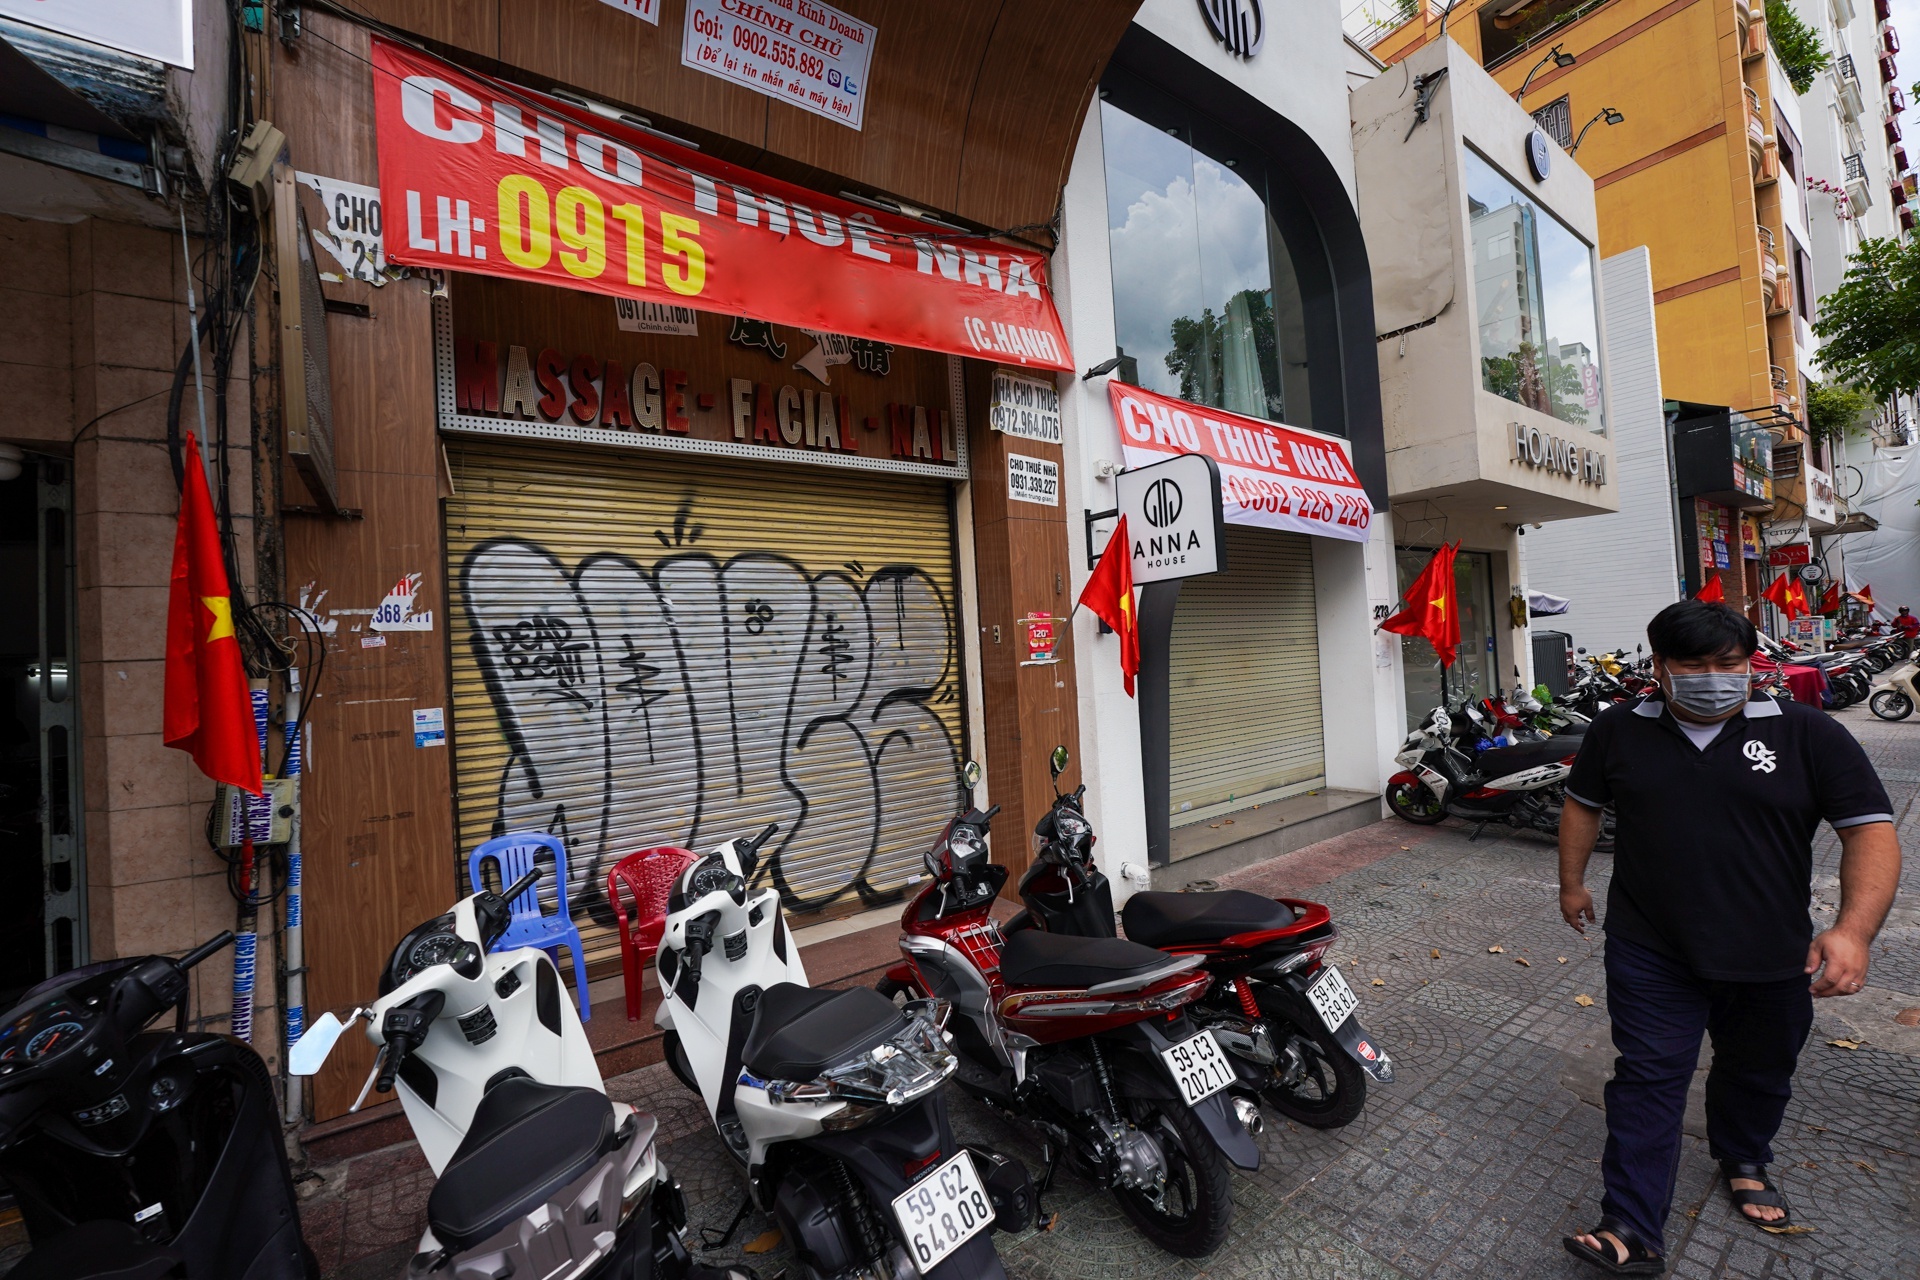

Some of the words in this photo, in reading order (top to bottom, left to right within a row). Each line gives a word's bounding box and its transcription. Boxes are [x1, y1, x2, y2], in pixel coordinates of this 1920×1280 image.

[721, 0, 795, 35] CHÍNH
[799, 29, 844, 56] CHỦ
[796, 0, 826, 26] Kinh
[828, 15, 865, 44] Doanh
[693, 9, 723, 42] Gọi:
[733, 25, 824, 80] 0902.555.882
[723, 53, 738, 72] lại
[743, 63, 758, 78] tin
[761, 71, 784, 88] nhắn
[809, 92, 828, 109] máy
[400, 75, 643, 186] CHO
[677, 168, 892, 264] THUÊ
[912, 236, 1043, 301] NHÀ
[335, 192, 382, 237] CHO
[406, 189, 487, 261] LH:
[497, 174, 706, 297] 0915
[963, 316, 1063, 365] (C.HẠNH)
[455, 338, 690, 433] MASSAGE
[730, 378, 859, 451] FACIAL
[888, 403, 957, 462] NAIL
[1013, 381, 1033, 408] CHO
[992, 406, 1059, 441] 0972.964.076
[1120, 396, 1201, 452] CHO
[1204, 418, 1291, 472] THUÊ
[1291, 441, 1356, 484] NHÀ
[1010, 458, 1024, 471] CHO
[1010, 473, 1057, 495] 0931.339.227
[1291, 486, 1334, 522] 228
[1334, 493, 1370, 529] 228
[1133, 529, 1201, 561] ANNA
[1769, 526, 1805, 537] CITIZEN
[1147, 554, 1187, 569] HOUSE
[1313, 972, 1341, 1006] 59-H1
[1322, 987, 1356, 1030] 769.82
[1171, 1035, 1216, 1072] 59-C3
[1181, 1057, 1232, 1101] 202.11
[906, 1164, 969, 1225] 59-G2
[912, 1163, 938, 1183] HONDA
[913, 1190, 988, 1264] 648.08
